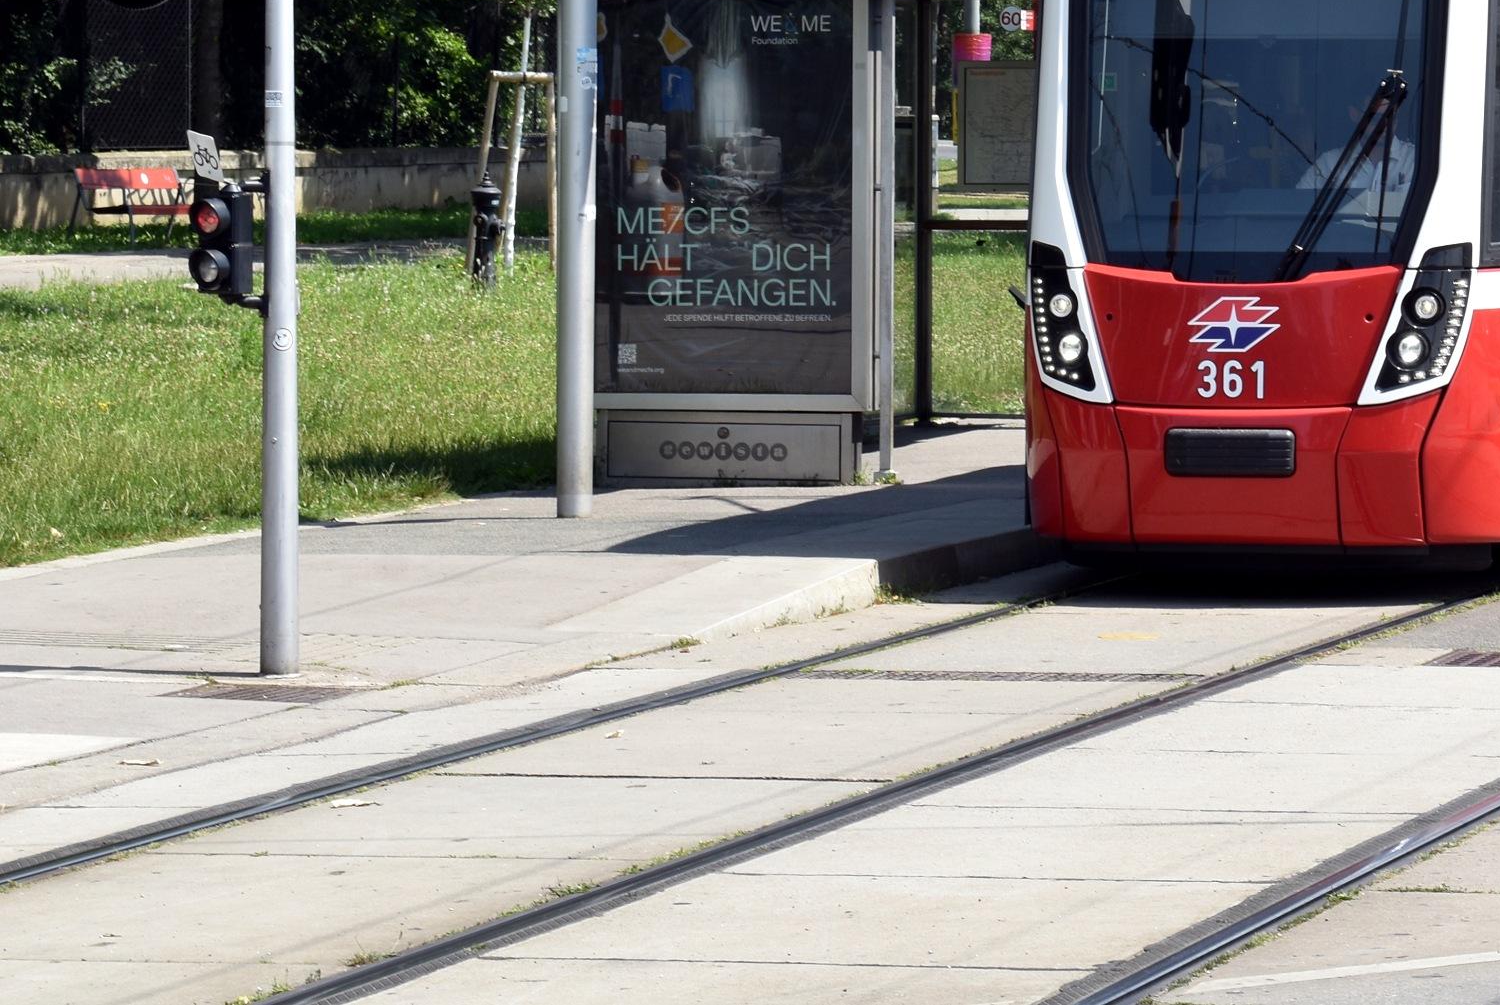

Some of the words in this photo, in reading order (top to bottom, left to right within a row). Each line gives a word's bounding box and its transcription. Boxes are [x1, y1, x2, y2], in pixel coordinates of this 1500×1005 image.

[750, 15, 782, 33] WE
[802, 15, 832, 33] ME
[1001, 11, 1020, 26] 60
[751, 36, 798, 45] Foundation
[617, 206, 750, 235] ME/CFS
[617, 238, 699, 271] HÄLT
[752, 243, 831, 272] DICH
[648, 278, 837, 306] GEFANGEN.
[664, 314, 682, 322] JEDE
[683, 314, 712, 322] SPENDE
[714, 314, 734, 322] HILFT
[735, 314, 783, 322] BETROFFENE
[1197, 359, 1265, 399] 361
[660, 441, 787, 461] gewista
